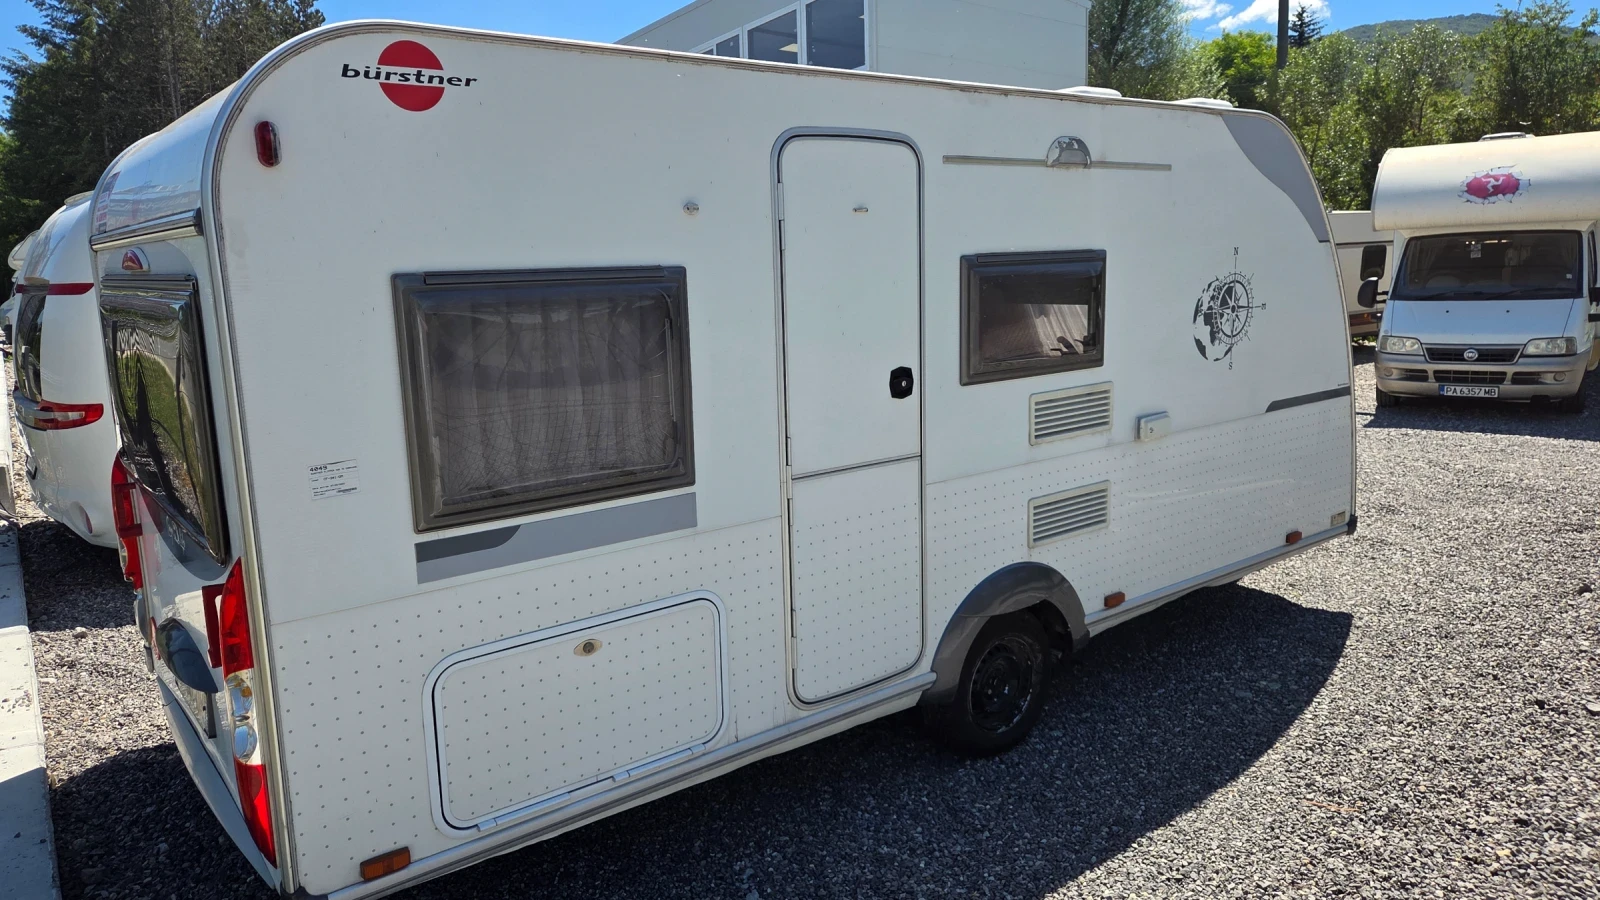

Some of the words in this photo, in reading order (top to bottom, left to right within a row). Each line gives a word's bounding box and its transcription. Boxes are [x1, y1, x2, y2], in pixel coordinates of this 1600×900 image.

[341, 64, 477, 87] bürstner
[1233, 247, 1239, 256] N
[1228, 362, 1233, 370] S
[1446, 387, 1458, 395] PA
[1460, 387, 1482, 396] 6357
[1484, 388, 1496, 397] MB
